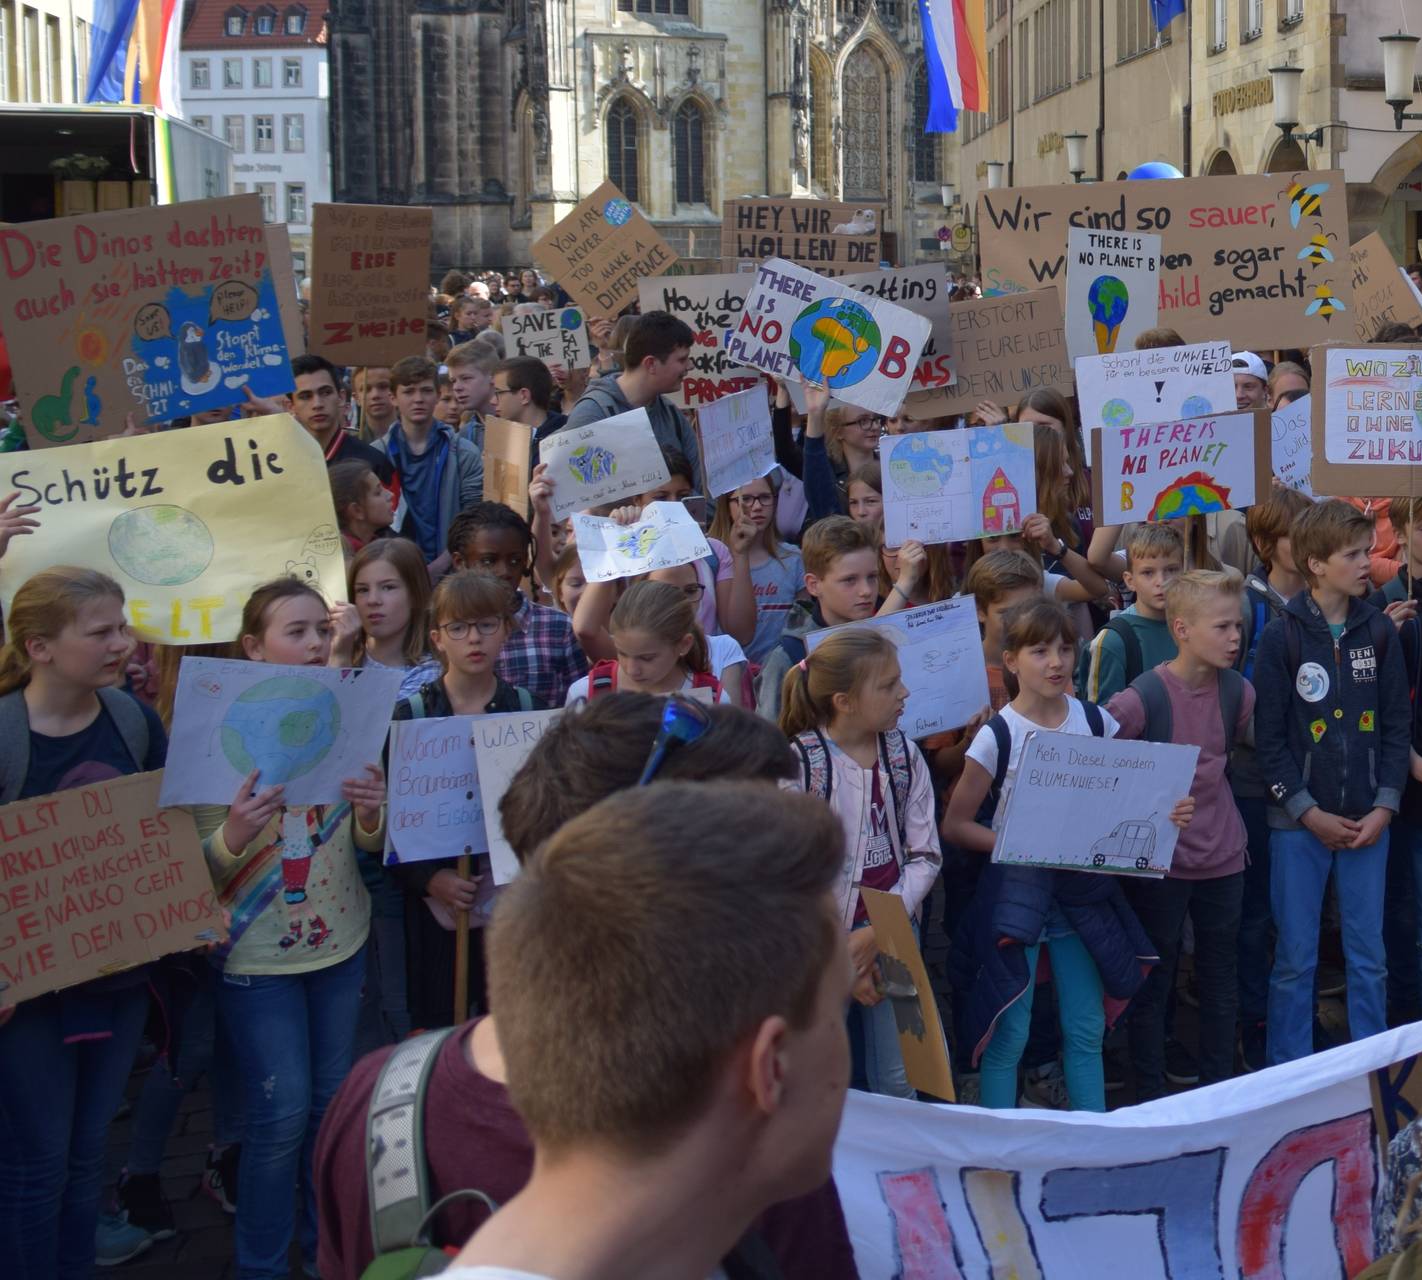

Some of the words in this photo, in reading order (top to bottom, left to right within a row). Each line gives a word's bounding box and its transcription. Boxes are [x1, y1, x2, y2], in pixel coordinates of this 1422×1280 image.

[792, 208, 831, 234] WIR
[984, 194, 1051, 232] Wir
[1069, 194, 1125, 232] sind
[1136, 206, 1171, 230] so
[1189, 202, 1276, 228] sauer,
[550, 231, 577, 253] YOU
[580, 205, 603, 233] ARE
[1088, 235, 1128, 250] THERE
[1132, 236, 1142, 250] IS
[0, 229, 61, 279] Die
[73, 224, 153, 264] Dinos
[167, 214, 264, 246] dachten
[351, 251, 397, 271] ERDE
[567, 233, 604, 267] NEVER
[737, 233, 836, 262] WOLLEN
[847, 241, 877, 263] DIE
[1079, 252, 1096, 265] NO
[1100, 253, 1143, 269] PLANET
[1148, 257, 1156, 271] B
[571, 263, 594, 283] TOO
[582, 282, 599, 297] TO
[600, 251, 632, 282] MAKE
[634, 240, 646, 253] A
[596, 244, 670, 311] DIFFERENCE
[1213, 246, 1285, 280] sogar
[14, 278, 74, 321] auch
[91, 274, 121, 304] sie
[133, 257, 203, 292] hätten
[209, 251, 266, 282] Zeit!
[758, 266, 817, 302] THERE
[1157, 274, 1201, 311] child
[1209, 269, 1317, 316] gemacht
[664, 288, 711, 313] How
[757, 294, 776, 314] IS
[323, 317, 425, 346] Zweite
[512, 312, 557, 335] SAVE
[695, 311, 732, 330] the
[739, 310, 782, 344] NO
[216, 324, 260, 350] Stoppt
[534, 343, 553, 359] THE
[976, 334, 1025, 361] EURE
[1028, 328, 1064, 352] WELT
[216, 351, 236, 362] den
[730, 336, 796, 377] PLANET
[878, 336, 911, 379] B
[1147, 353, 1165, 365] die
[1173, 346, 1229, 363] UMWELT
[1105, 370, 1119, 381] für
[1119, 424, 1196, 449] THERE
[1199, 420, 1216, 440] IS
[1346, 415, 1413, 432] OHNE
[11, 456, 164, 508] Schütz
[207, 436, 284, 485] die
[1121, 453, 1148, 475] NO
[1158, 441, 1228, 471] PLANET
[1120, 480, 1134, 511] B
[126, 597, 225, 639] ELT
[399, 726, 462, 761] Warum
[1036, 743, 1062, 762] Kein
[1067, 747, 1106, 767] Diesel
[1113, 756, 1156, 771] sondern
[1029, 772, 1119, 792] BLUMENWIESE!
[81, 787, 112, 818] DU
[82, 823, 126, 853] DASS
[139, 811, 171, 838] ES
[393, 806, 431, 832] aber
[62, 839, 171, 892] MENSCHEN
[134, 860, 185, 896] GEHT
[0, 941, 57, 985] WIE
[71, 919, 123, 960] DEN
